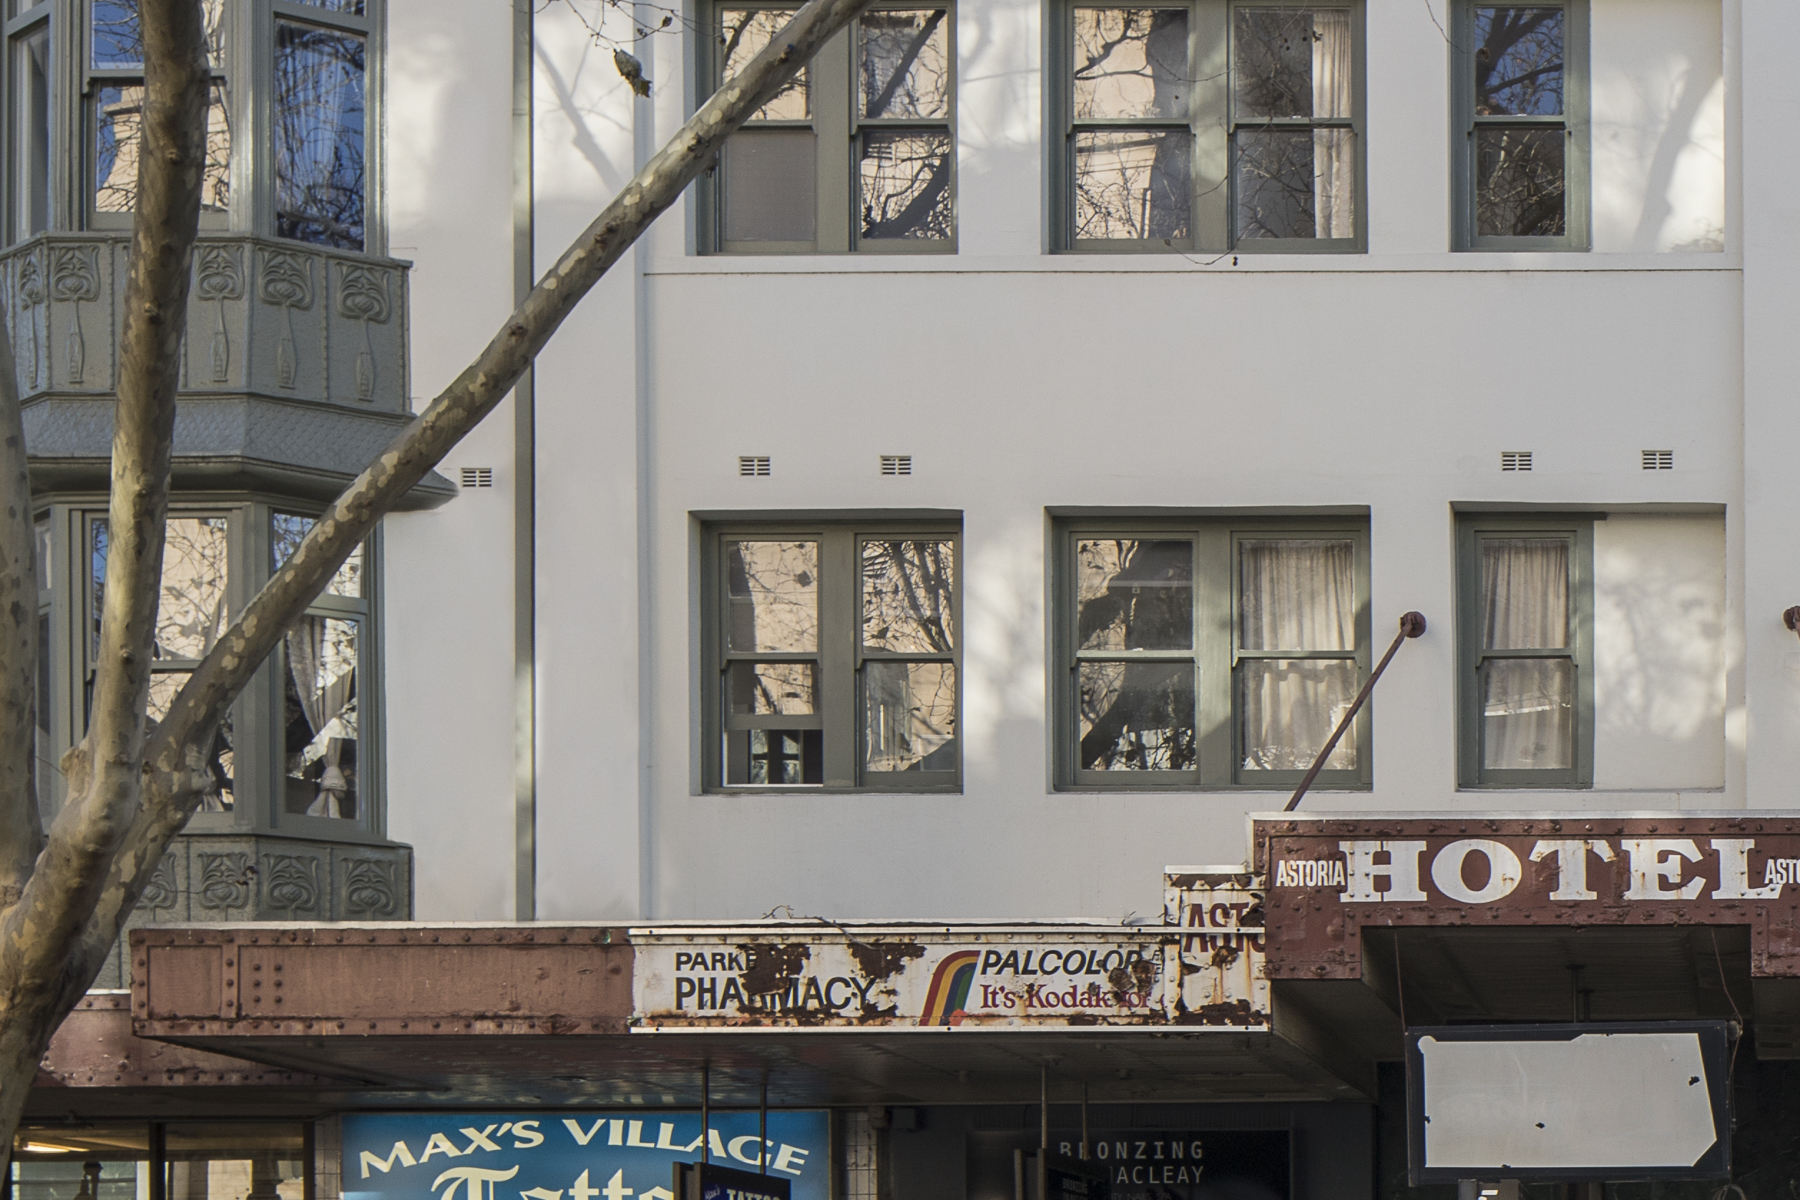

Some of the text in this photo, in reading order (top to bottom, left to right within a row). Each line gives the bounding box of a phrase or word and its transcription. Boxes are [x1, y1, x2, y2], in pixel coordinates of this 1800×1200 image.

[1275, 860, 1345, 887] ASTORIA
[1339, 839, 1782, 903] HOTEL
[979, 984, 1016, 1009] It's
[1026, 984, 1112, 1009] Kodak
[359, 1118, 810, 1179] MAX'S VILLAGE
[1109, 1166, 1203, 1184] ACLEAY
